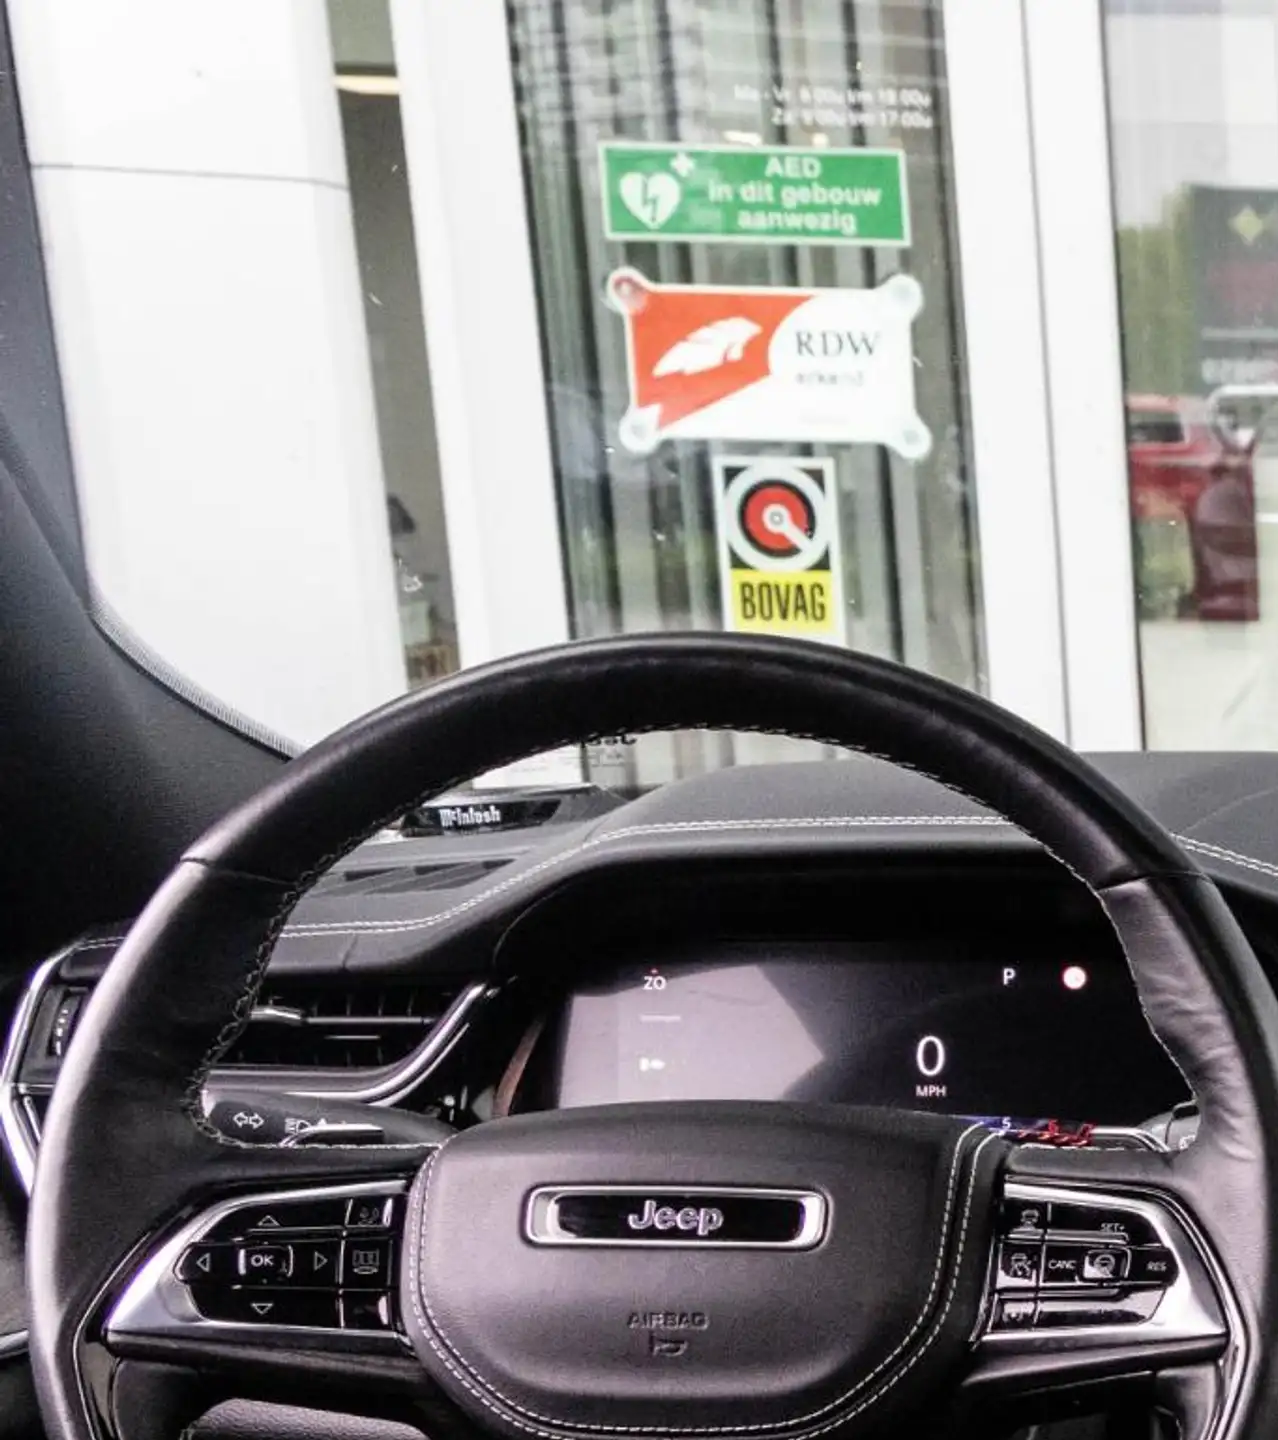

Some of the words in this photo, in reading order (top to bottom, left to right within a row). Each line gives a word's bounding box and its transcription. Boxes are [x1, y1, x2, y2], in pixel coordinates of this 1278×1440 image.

[765, 155, 823, 178] AED
[740, 181, 775, 204] dit
[781, 183, 882, 209] gebouw
[736, 210, 858, 236] aanwezig
[796, 330, 882, 357] RDW
[740, 582, 826, 622] BOVAG
[1003, 967, 1017, 986] P
[916, 1034, 946, 1078] 0
[915, 1084, 948, 1098] MPH
[628, 1199, 725, 1237] Jeep
[250, 1254, 275, 1267] OK
[627, 1311, 711, 1331] AIRBAG
